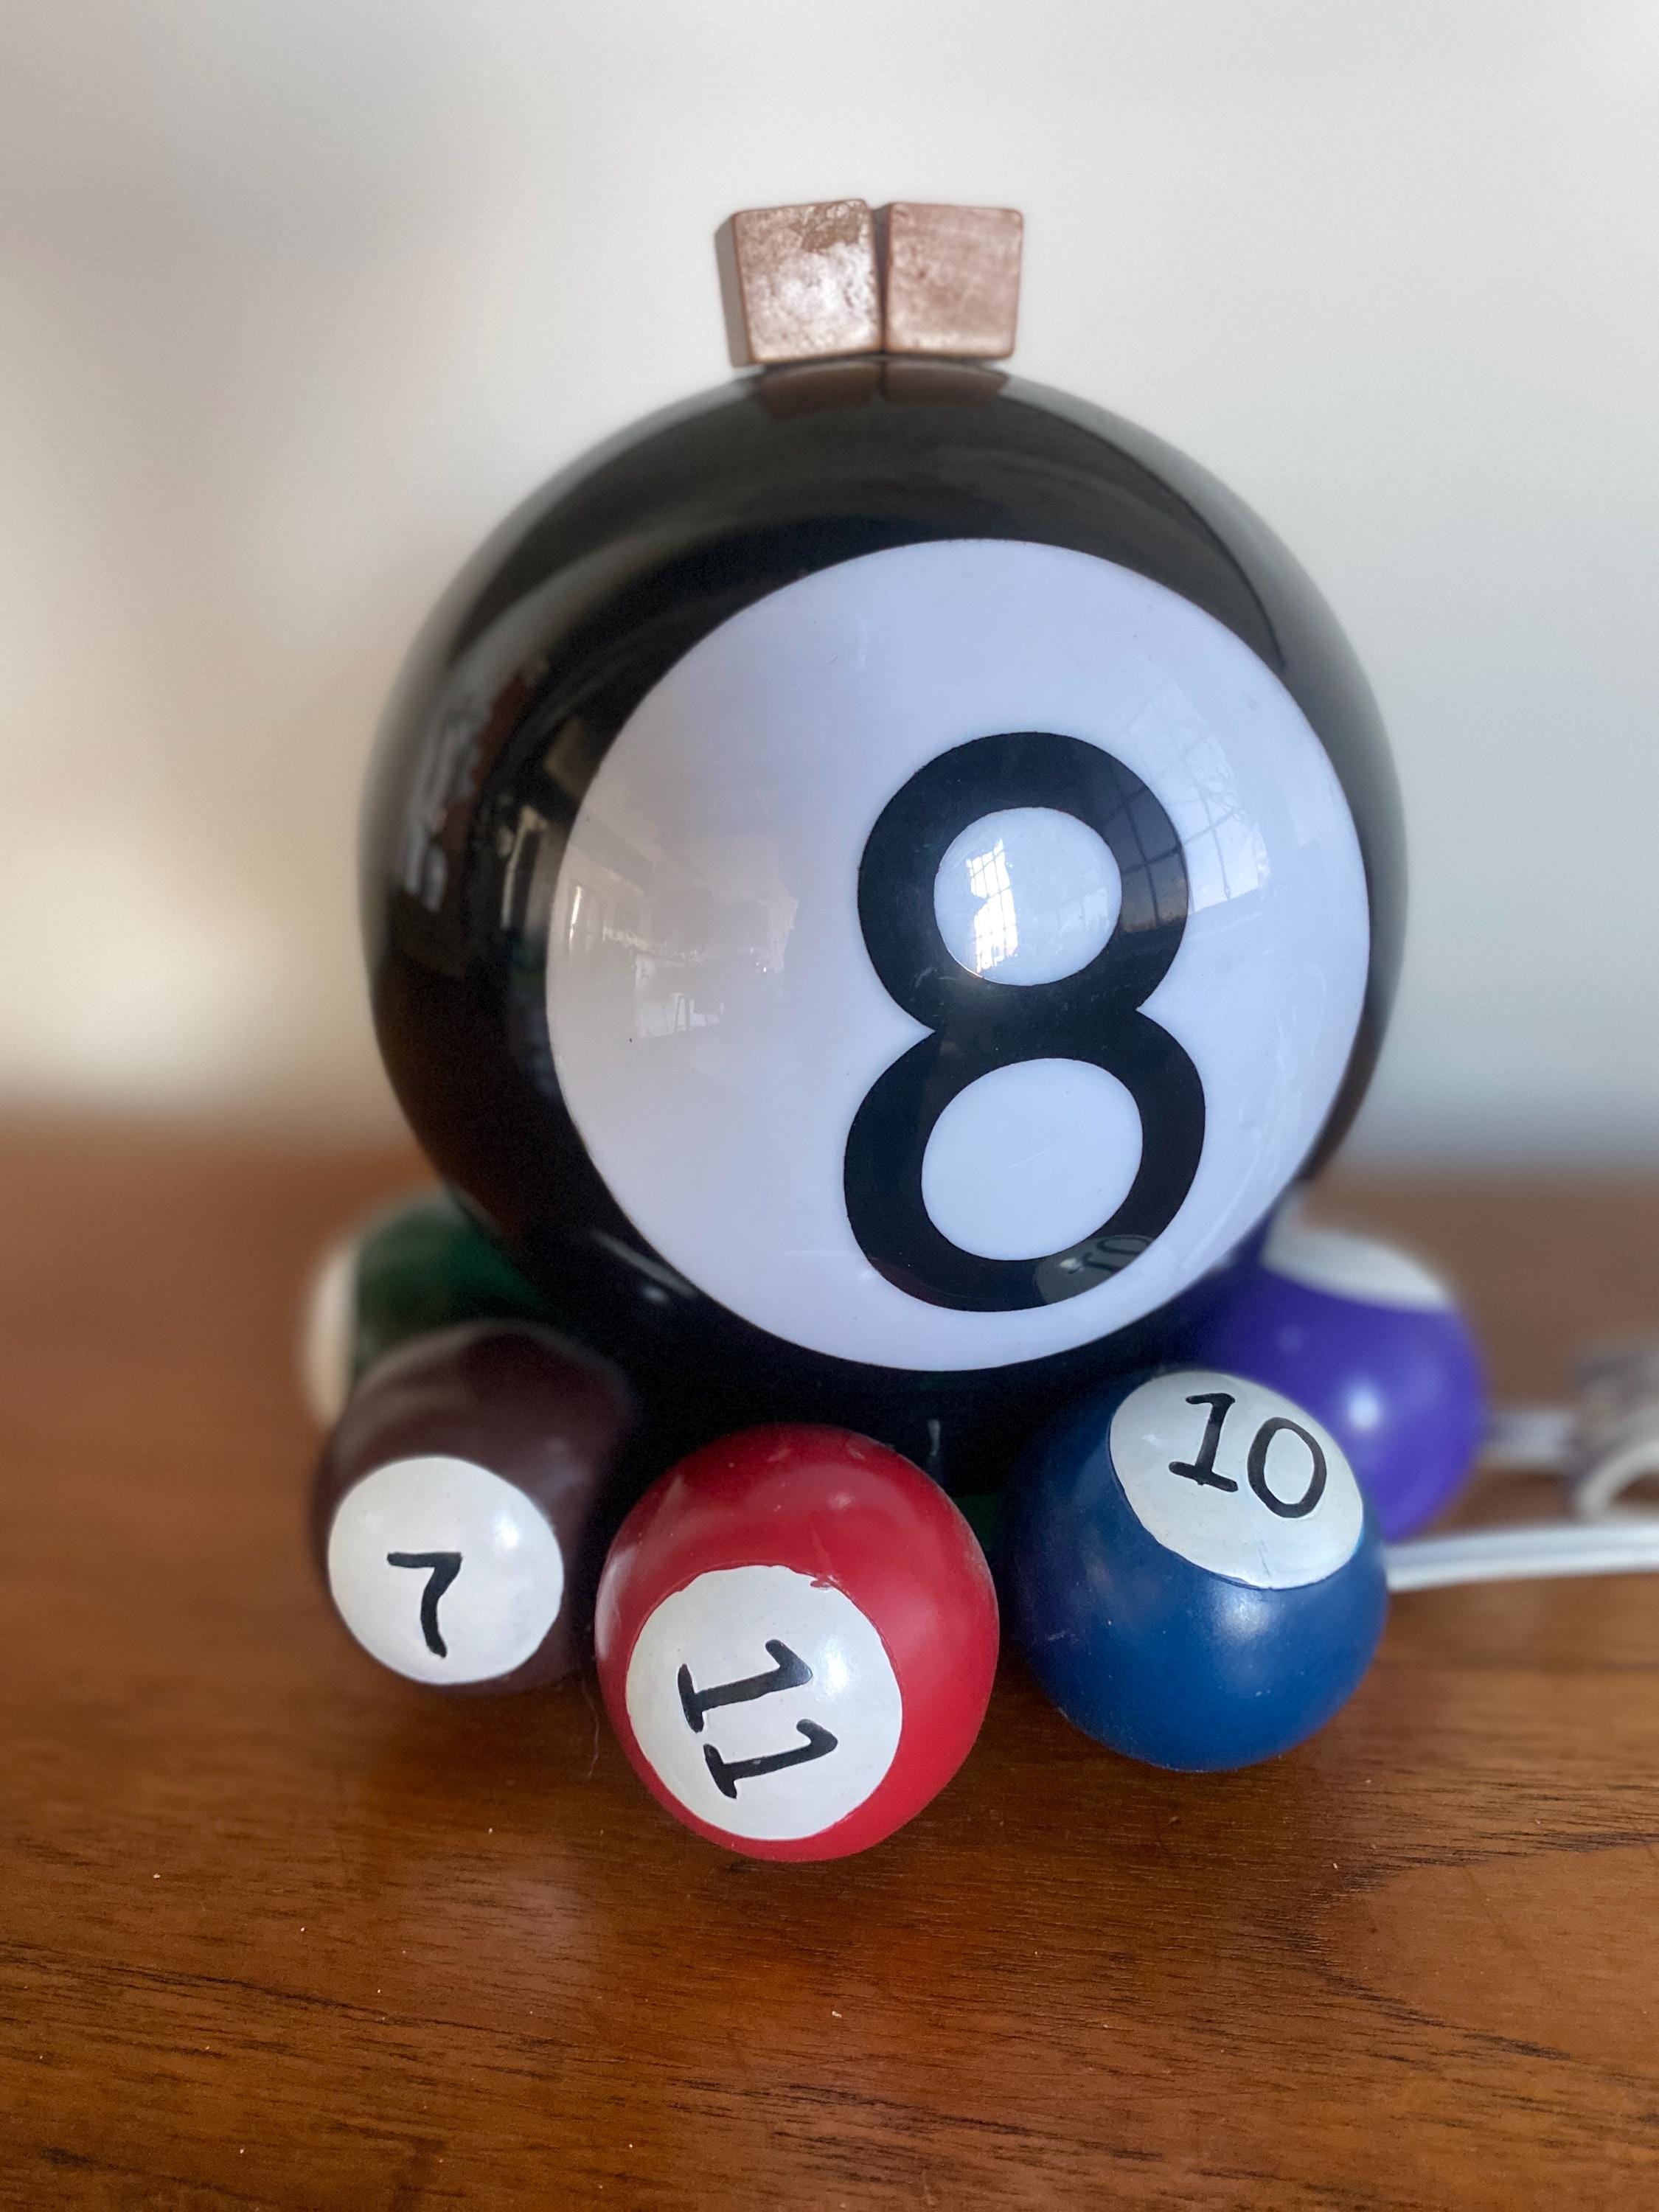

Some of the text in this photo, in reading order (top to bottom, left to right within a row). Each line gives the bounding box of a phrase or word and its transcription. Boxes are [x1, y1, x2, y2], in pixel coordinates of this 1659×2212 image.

[844, 731, 1206, 1312] 8
[1168, 1392, 1327, 1519] 10
[387, 1553, 462, 1658] 7
[678, 1638, 838, 1800] 11
